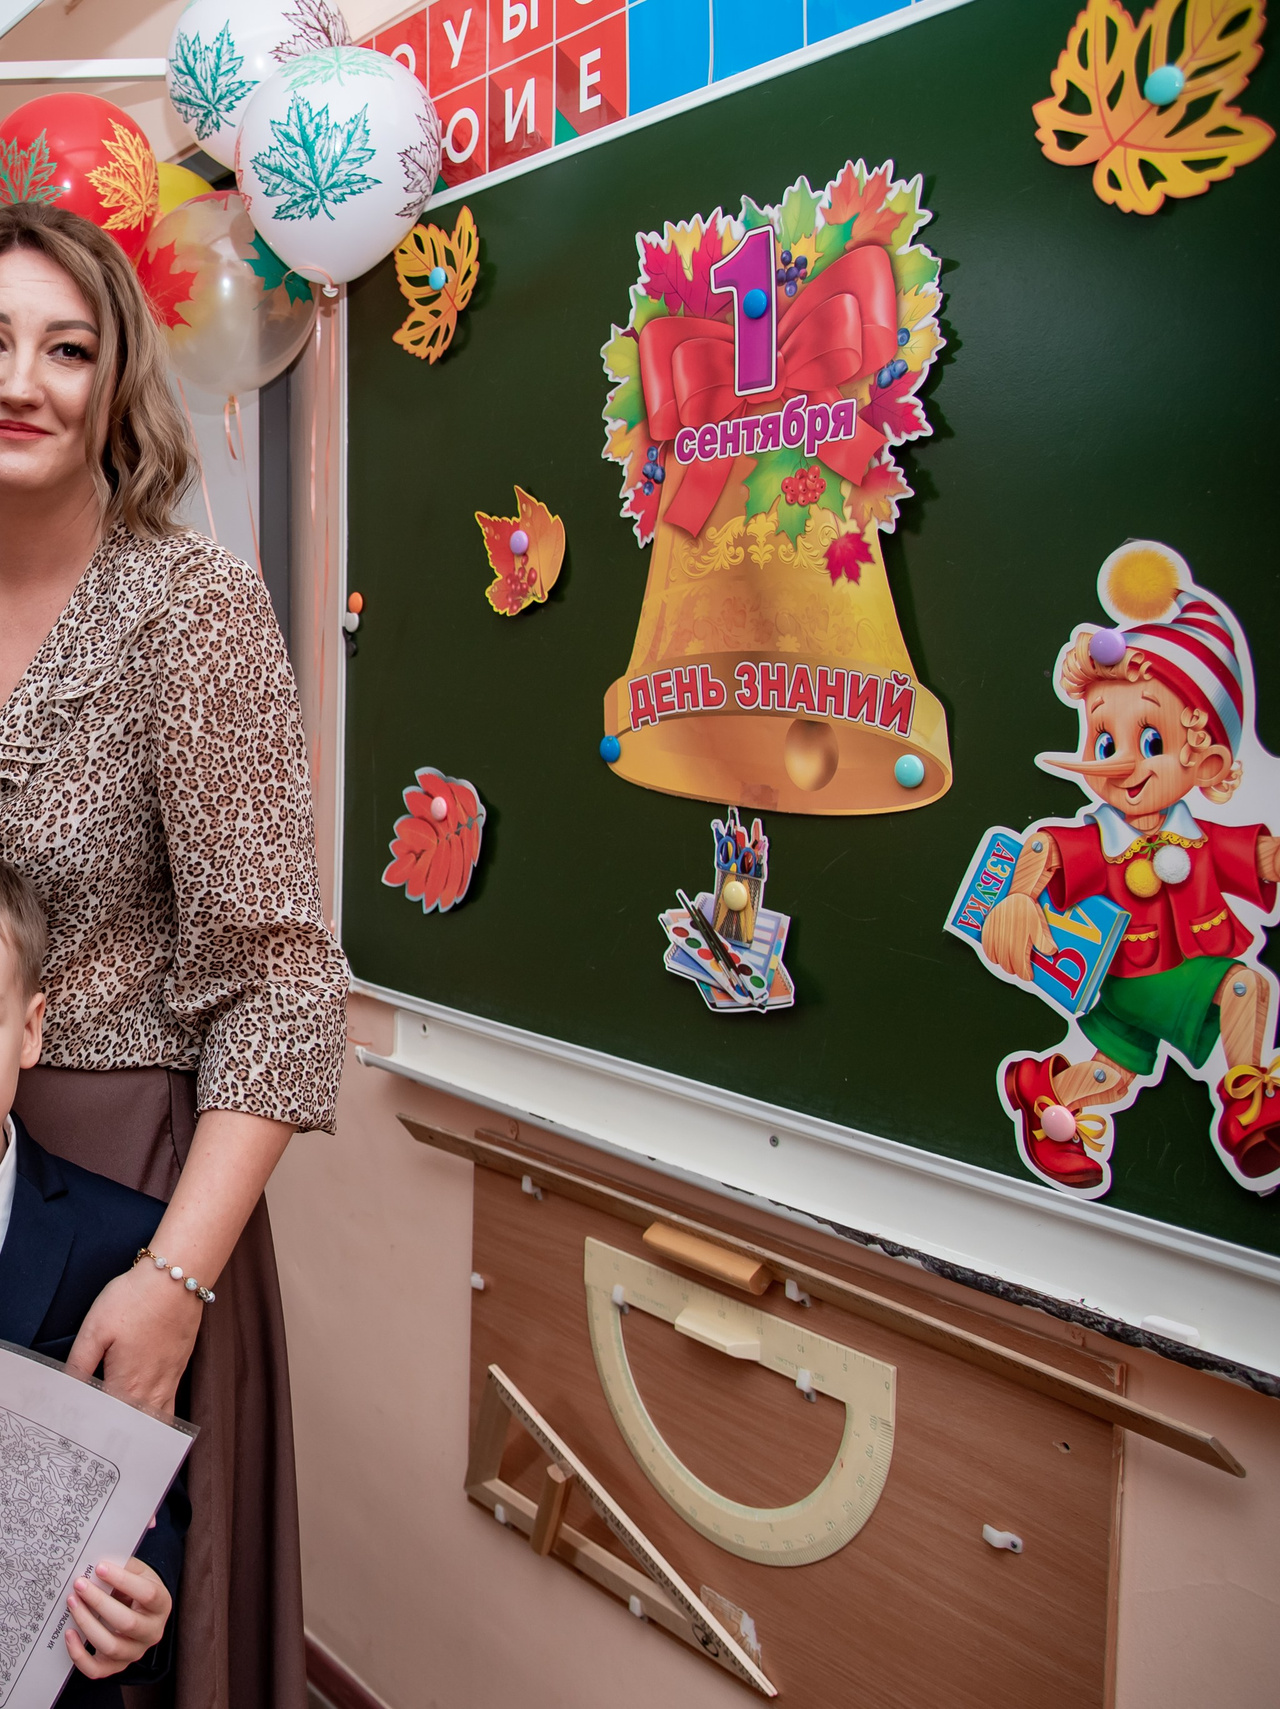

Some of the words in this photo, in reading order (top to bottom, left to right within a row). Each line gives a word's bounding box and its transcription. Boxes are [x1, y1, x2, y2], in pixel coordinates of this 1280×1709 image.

[442, 8, 472, 69] У
[502, 0, 539, 43] Ы
[504, 77, 536, 144] И
[579, 47, 602, 113] Е
[710, 224, 777, 396] 1
[674, 396, 856, 464] сентября
[628, 664, 726, 732] ДЕНЬ
[735, 662, 916, 738] ЗНАНИЙ
[957, 841, 1016, 931] АЗБУКА
[46, 1639, 56, 1651] ИХ
[51, 1611, 70, 1641] РАСКРАСЬ
